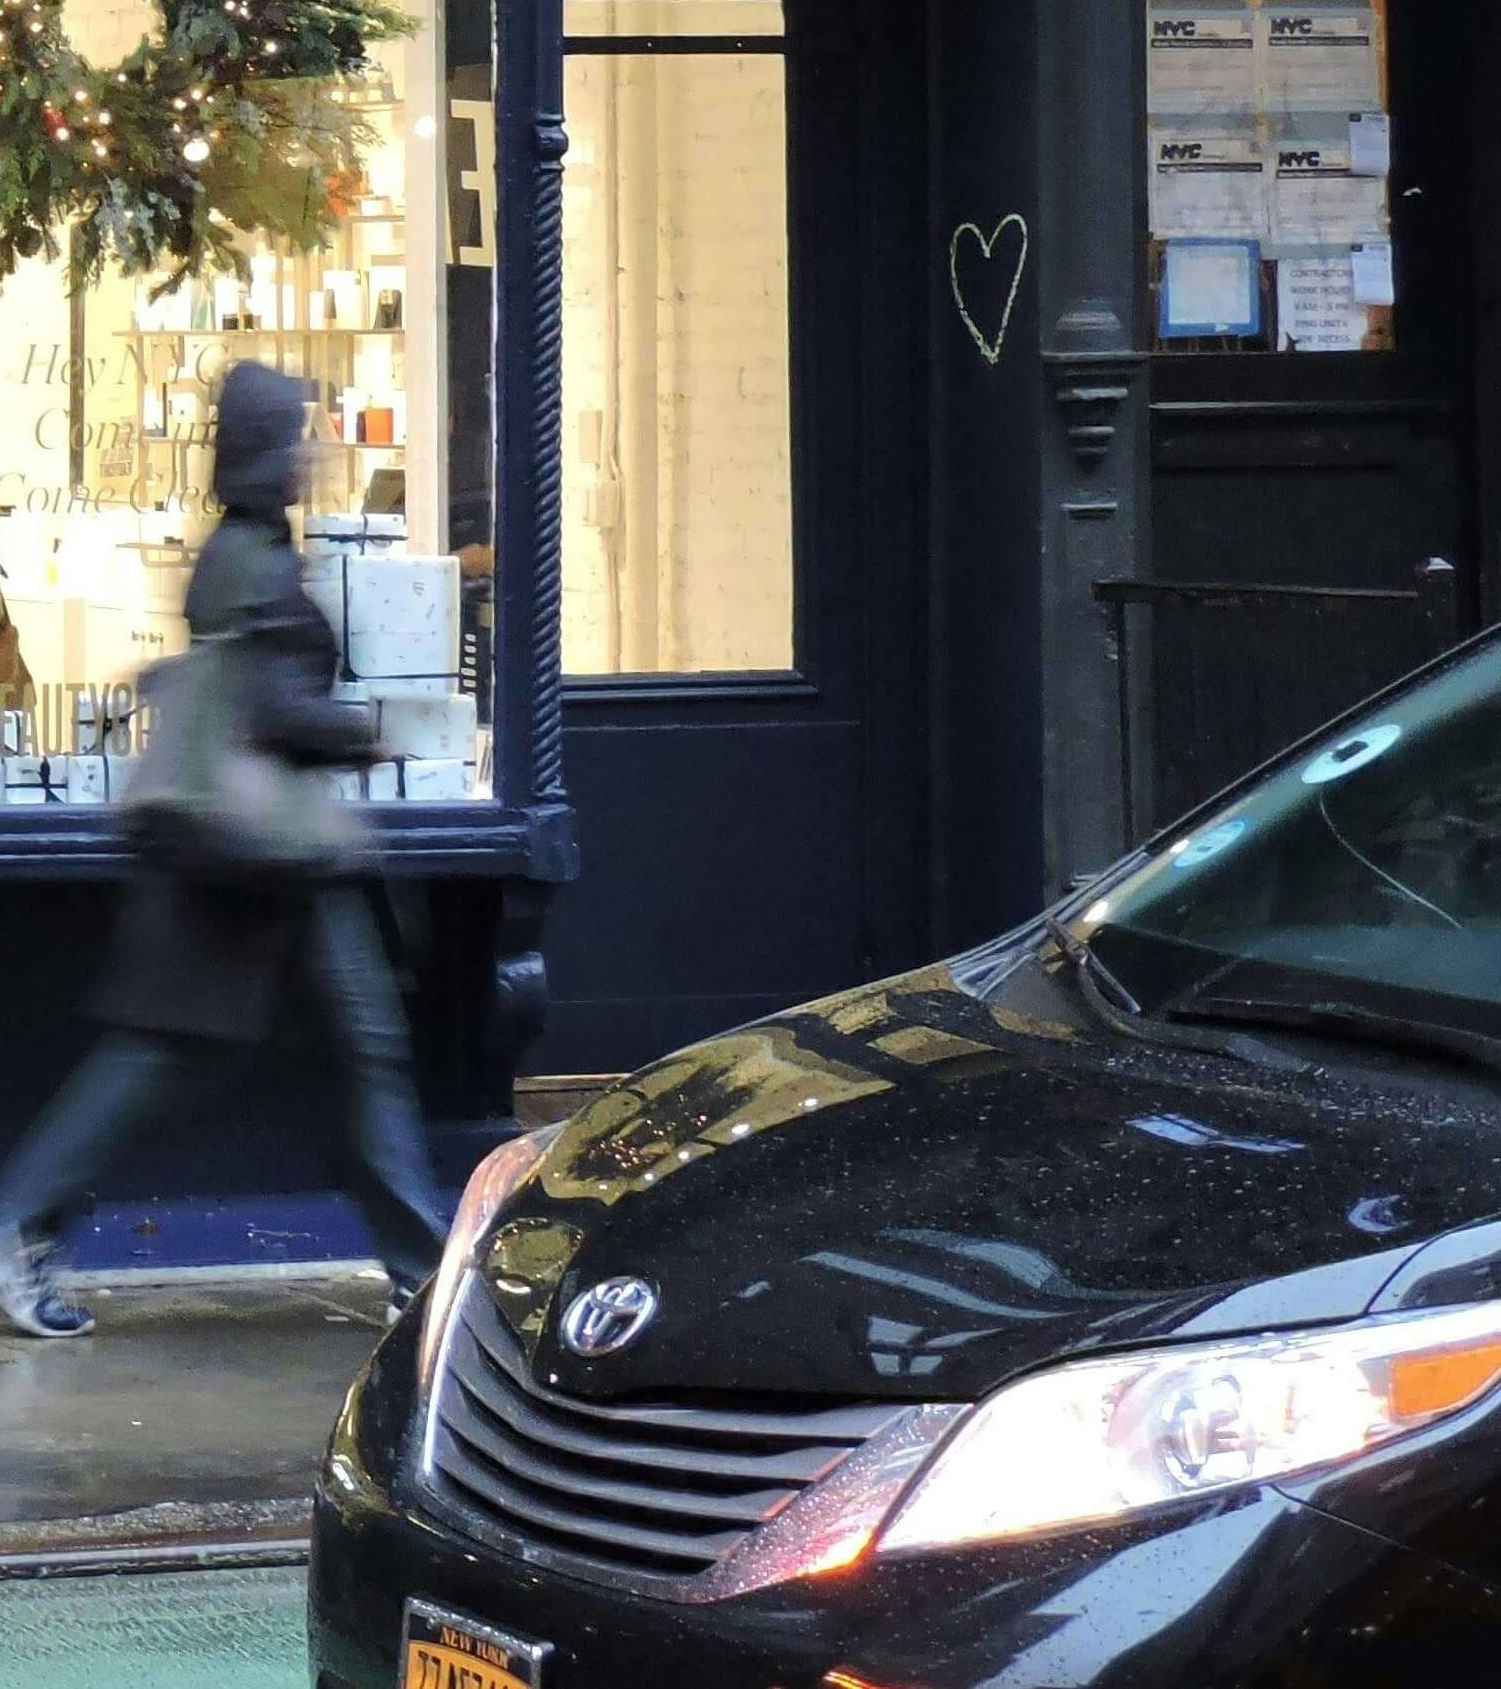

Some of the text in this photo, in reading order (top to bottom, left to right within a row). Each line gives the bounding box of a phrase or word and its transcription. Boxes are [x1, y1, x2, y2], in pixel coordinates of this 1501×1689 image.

[1153, 20, 1196, 36] NYC
[1270, 18, 1313, 34] NYC
[1160, 143, 1202, 160] NYC
[1278, 151, 1320, 167] NYC
[130, 466, 228, 514] Clea
